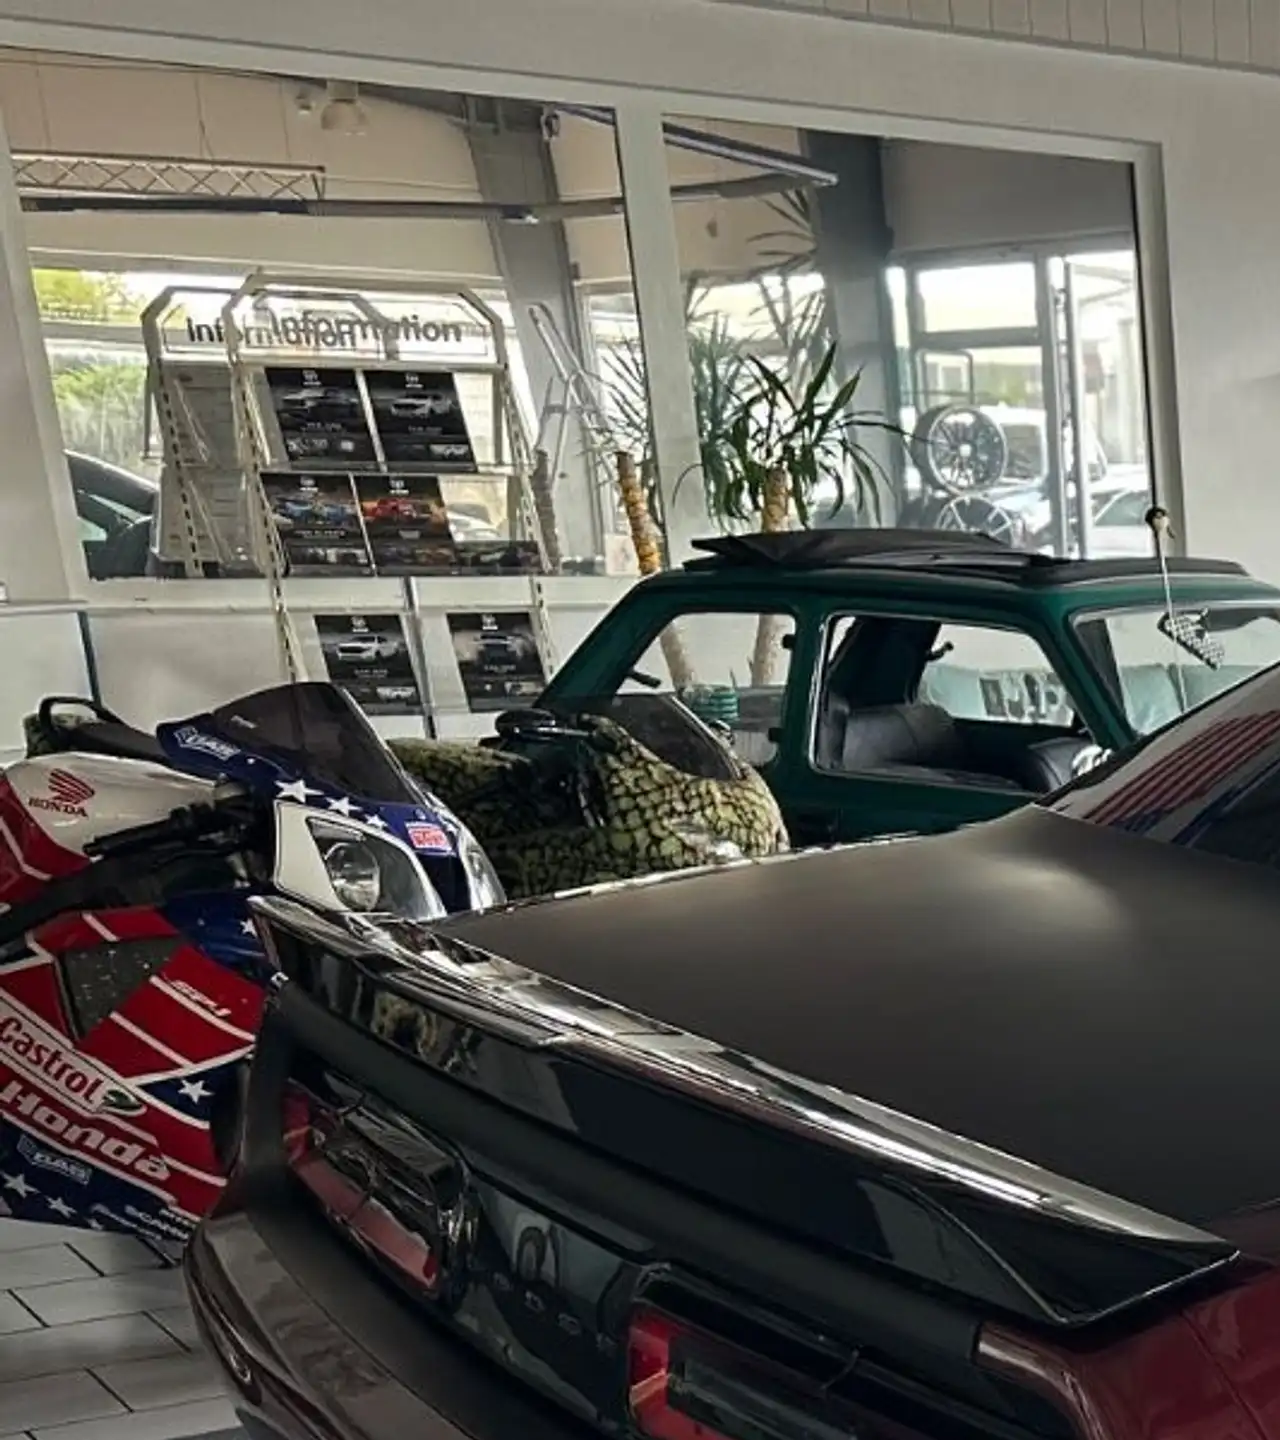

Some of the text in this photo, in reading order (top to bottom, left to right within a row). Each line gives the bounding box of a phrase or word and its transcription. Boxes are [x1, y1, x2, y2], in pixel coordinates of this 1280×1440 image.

[28, 796, 90, 819] HONDA
[0, 1017, 104, 1103] Castrol
[0, 1079, 172, 1182] Honda
